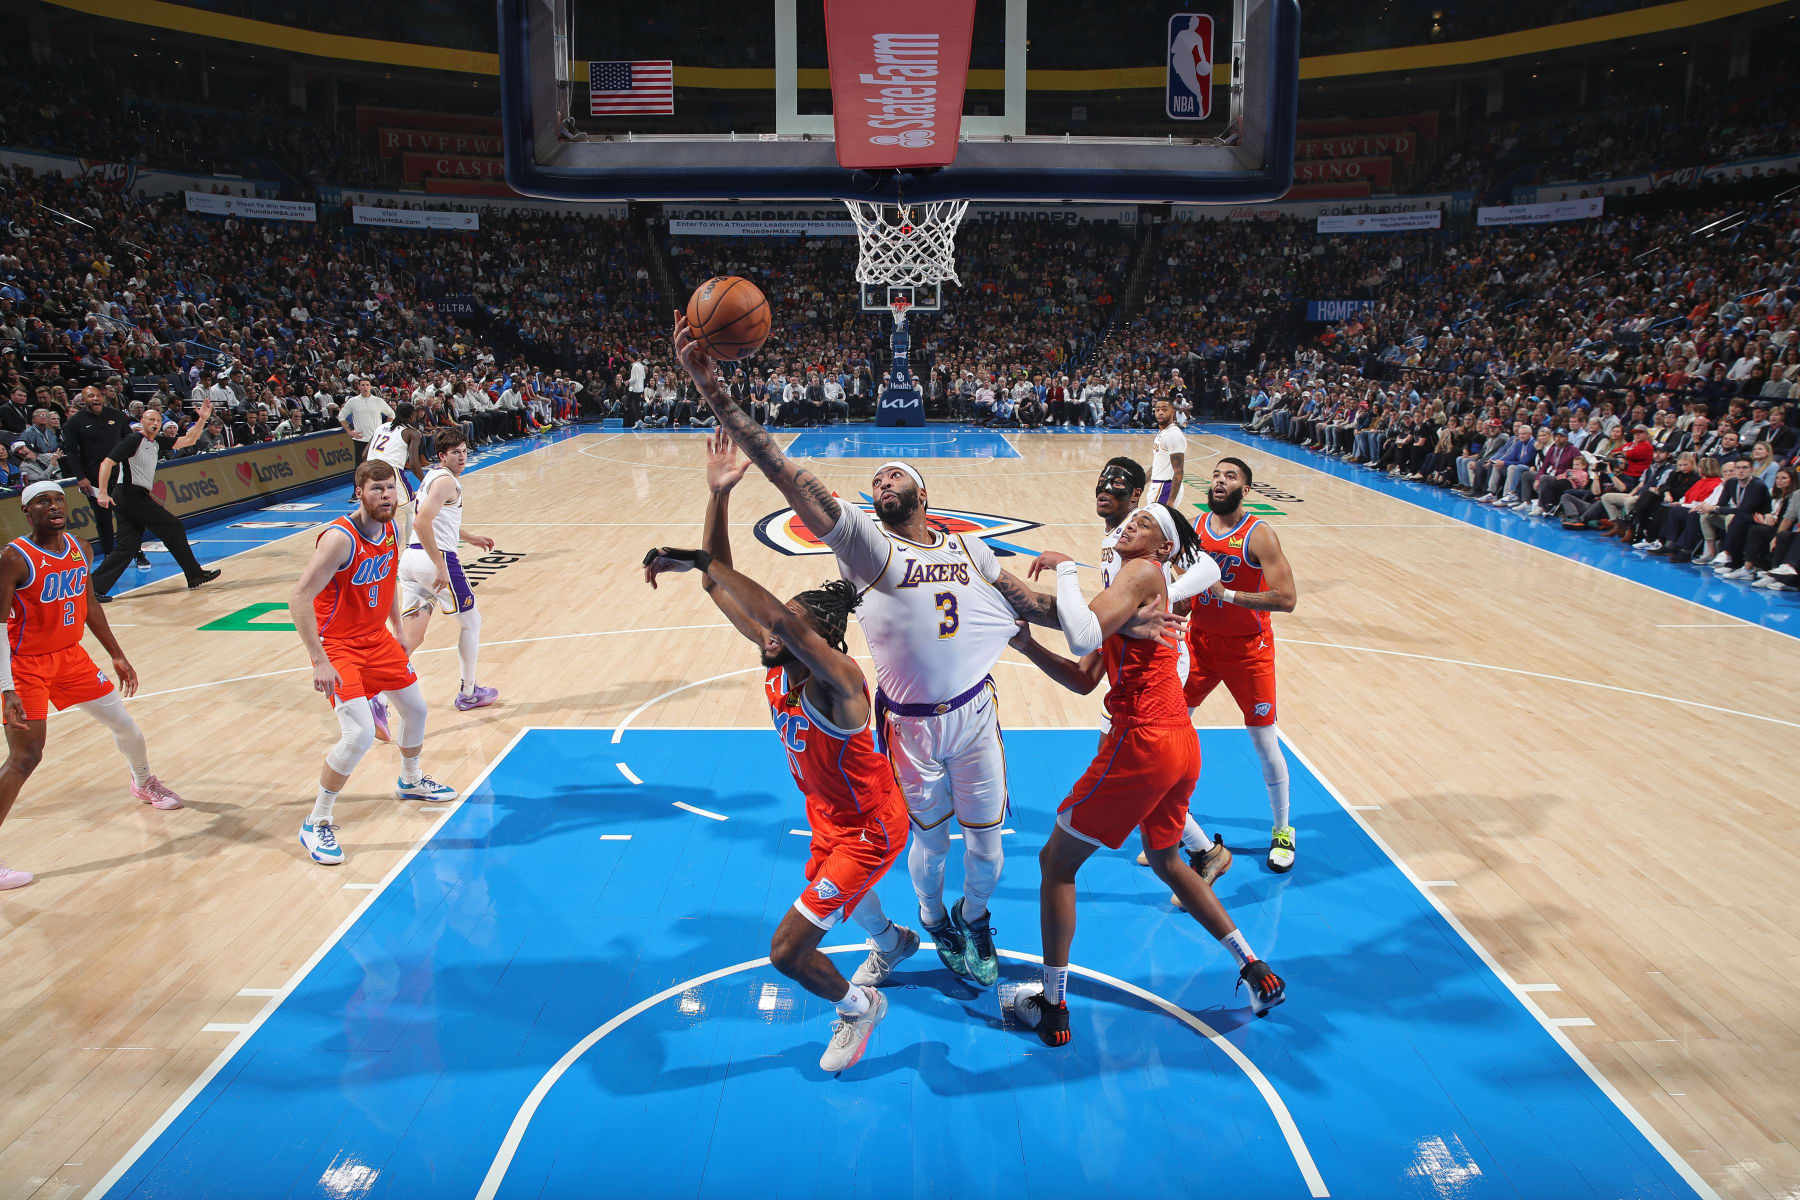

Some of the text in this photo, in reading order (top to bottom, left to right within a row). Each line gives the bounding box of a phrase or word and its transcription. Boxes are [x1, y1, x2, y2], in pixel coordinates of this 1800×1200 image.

[1173, 95, 1195, 112] NBA
[386, 131, 503, 153] RIVERWI
[1295, 137, 1409, 158] ERWIND
[436, 159, 506, 176] CASIN
[1302, 162, 1361, 179] SINO
[359, 215, 421, 225] ThunderMBA.com
[977, 211, 1077, 224] THUNDER
[438, 303, 473, 312] ULTRA
[890, 382, 911, 390] Health
[372, 434, 390, 453] 12
[351, 549, 394, 586] OKC
[895, 558, 970, 589] LAKERS
[40, 566, 88, 603] OKC
[369, 584, 378, 607] 9
[63, 601, 75, 627] 2
[934, 590, 959, 639] 3
